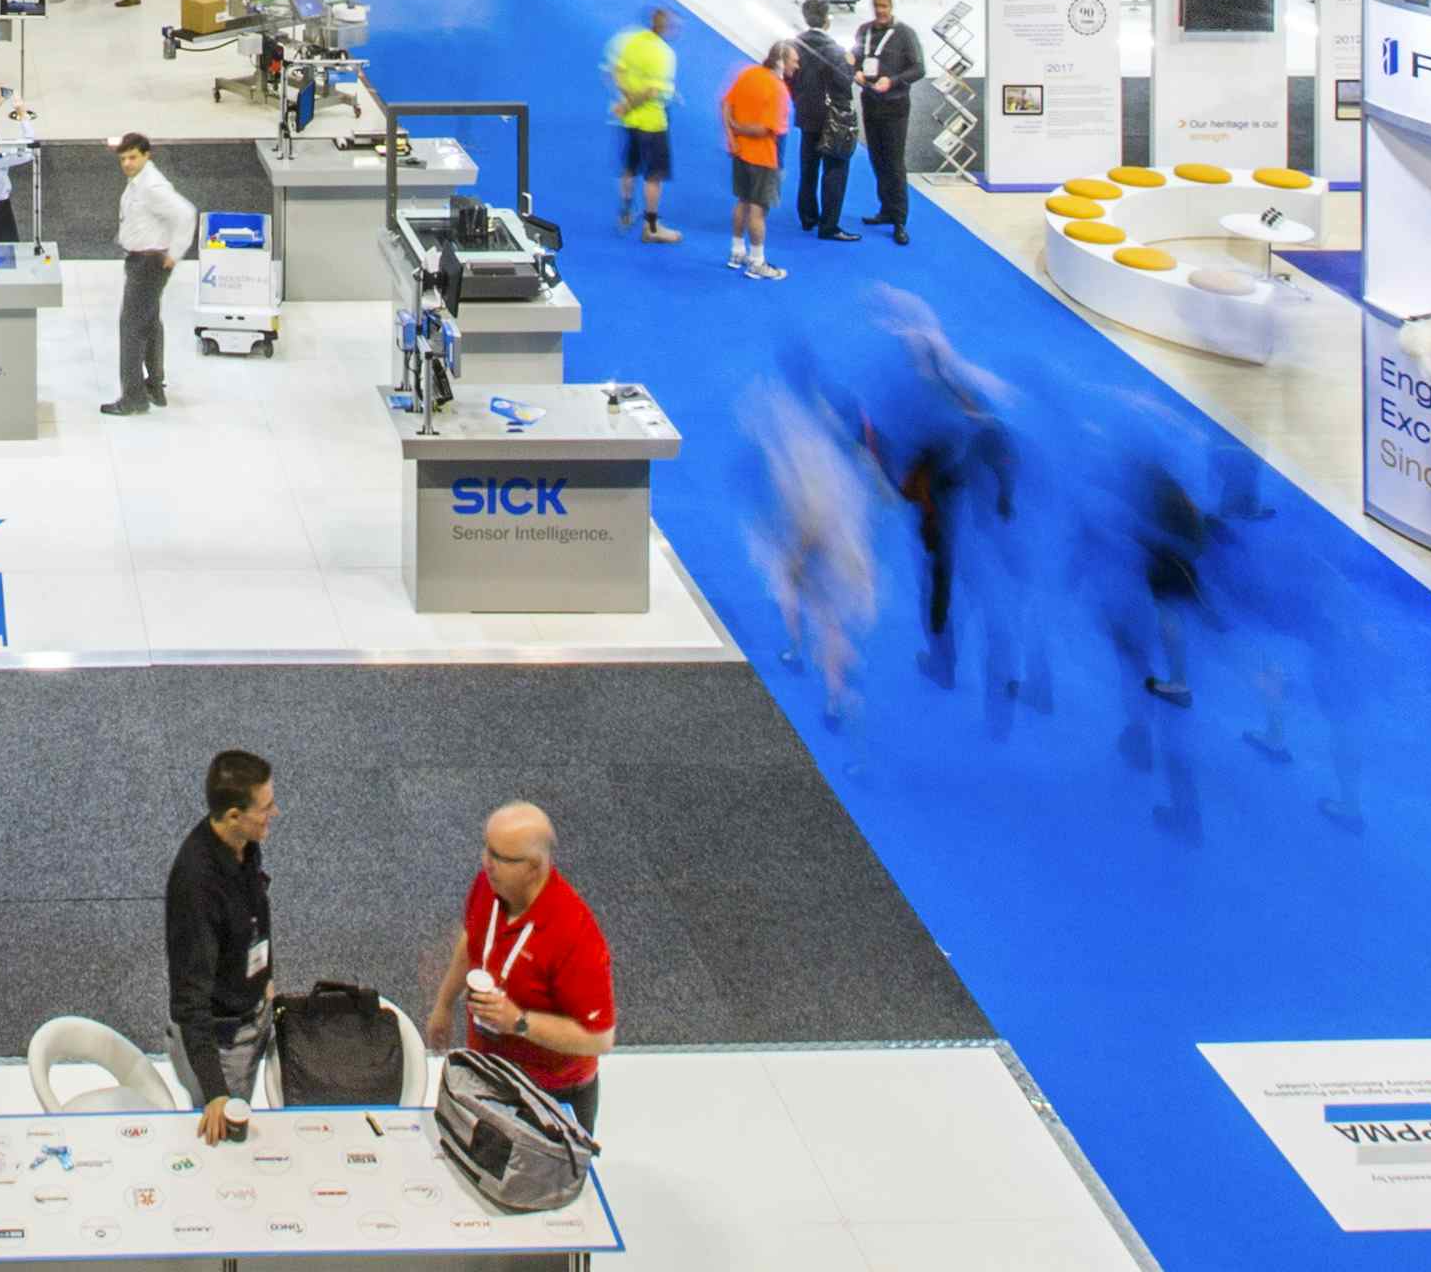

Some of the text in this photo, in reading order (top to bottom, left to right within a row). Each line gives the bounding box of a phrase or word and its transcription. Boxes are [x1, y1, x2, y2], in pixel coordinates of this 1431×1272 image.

[1210, 119, 1250, 132] heritage
[451, 476, 568, 516] SICK
[451, 524, 614, 544] Sensor Intelligence.
